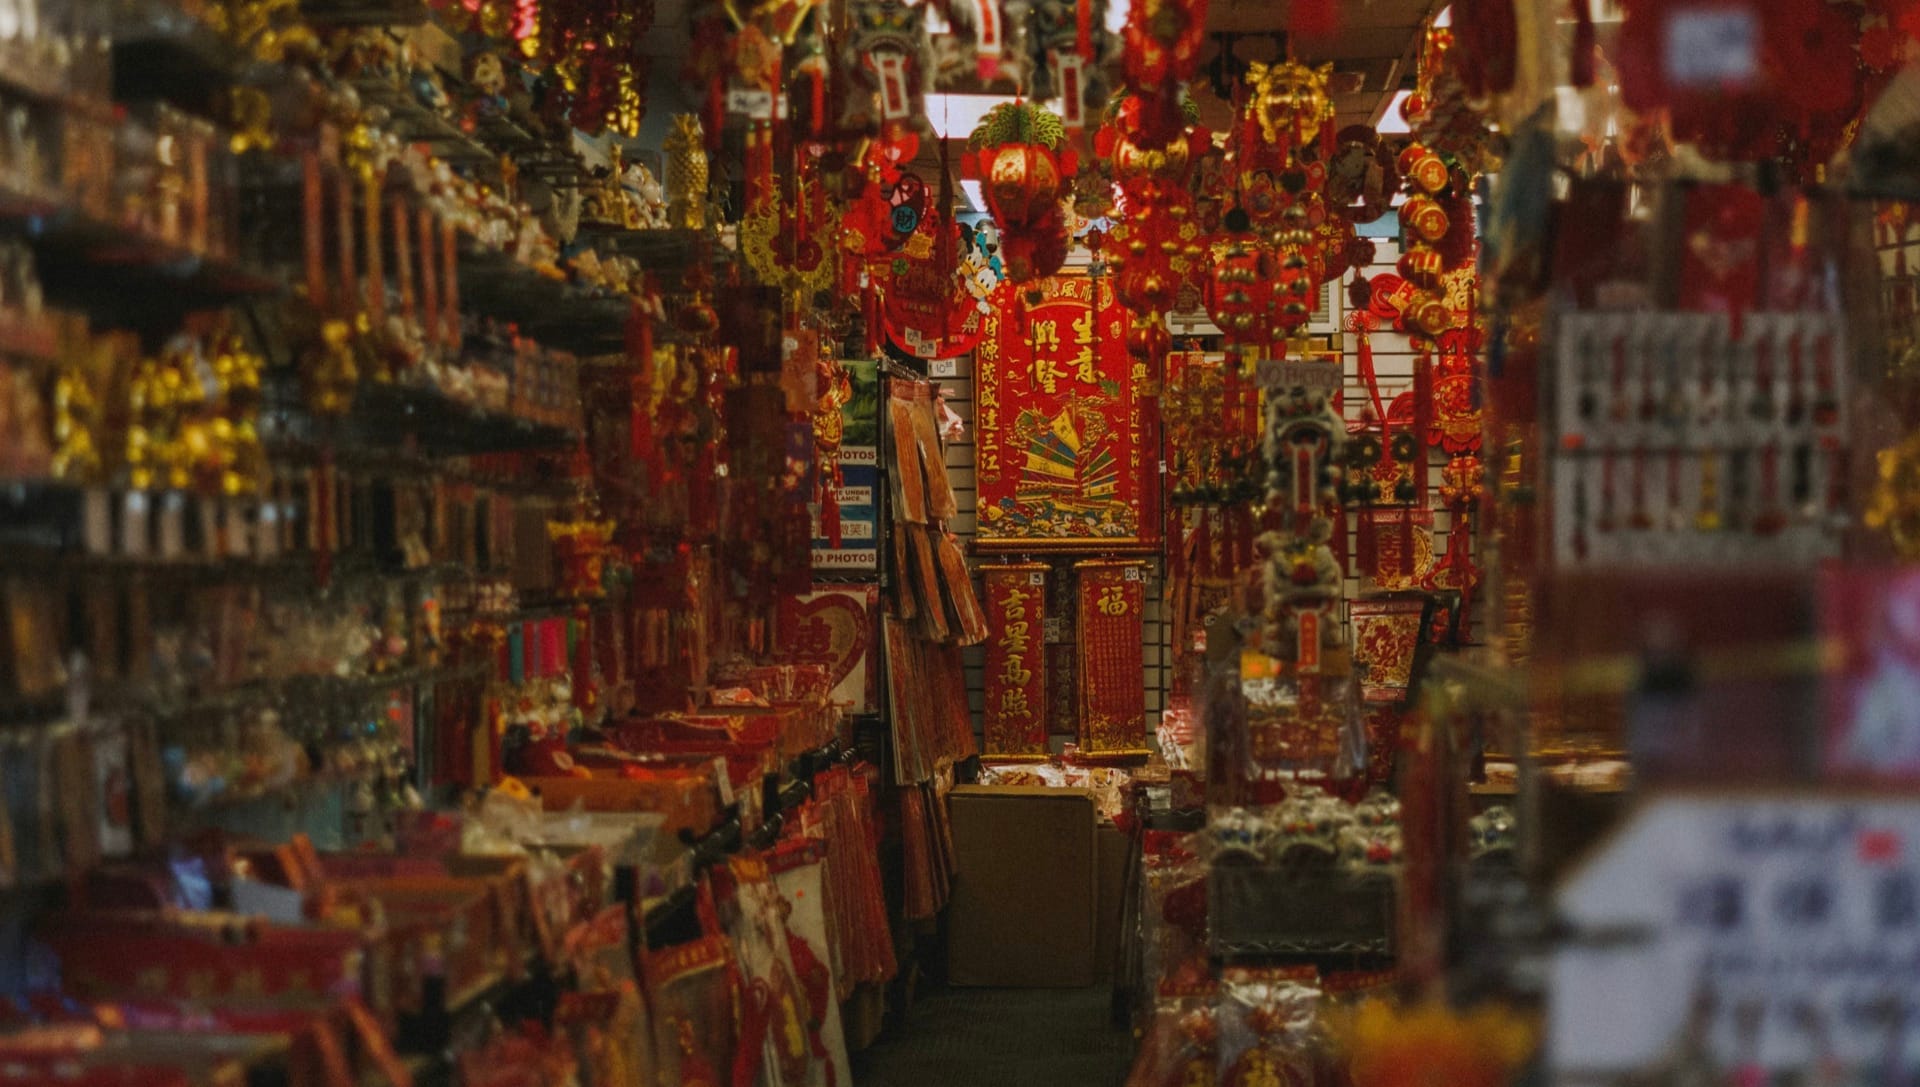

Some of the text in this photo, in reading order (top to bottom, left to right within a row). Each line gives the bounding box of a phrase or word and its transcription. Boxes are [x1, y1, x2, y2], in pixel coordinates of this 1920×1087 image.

[839, 450, 875, 460] OTOS
[826, 553, 875, 563] PHOTOS
[1126, 569, 1138, 579] 20
[1097, 586, 1128, 616] 福
[998, 589, 1032, 719] 吉星高照
